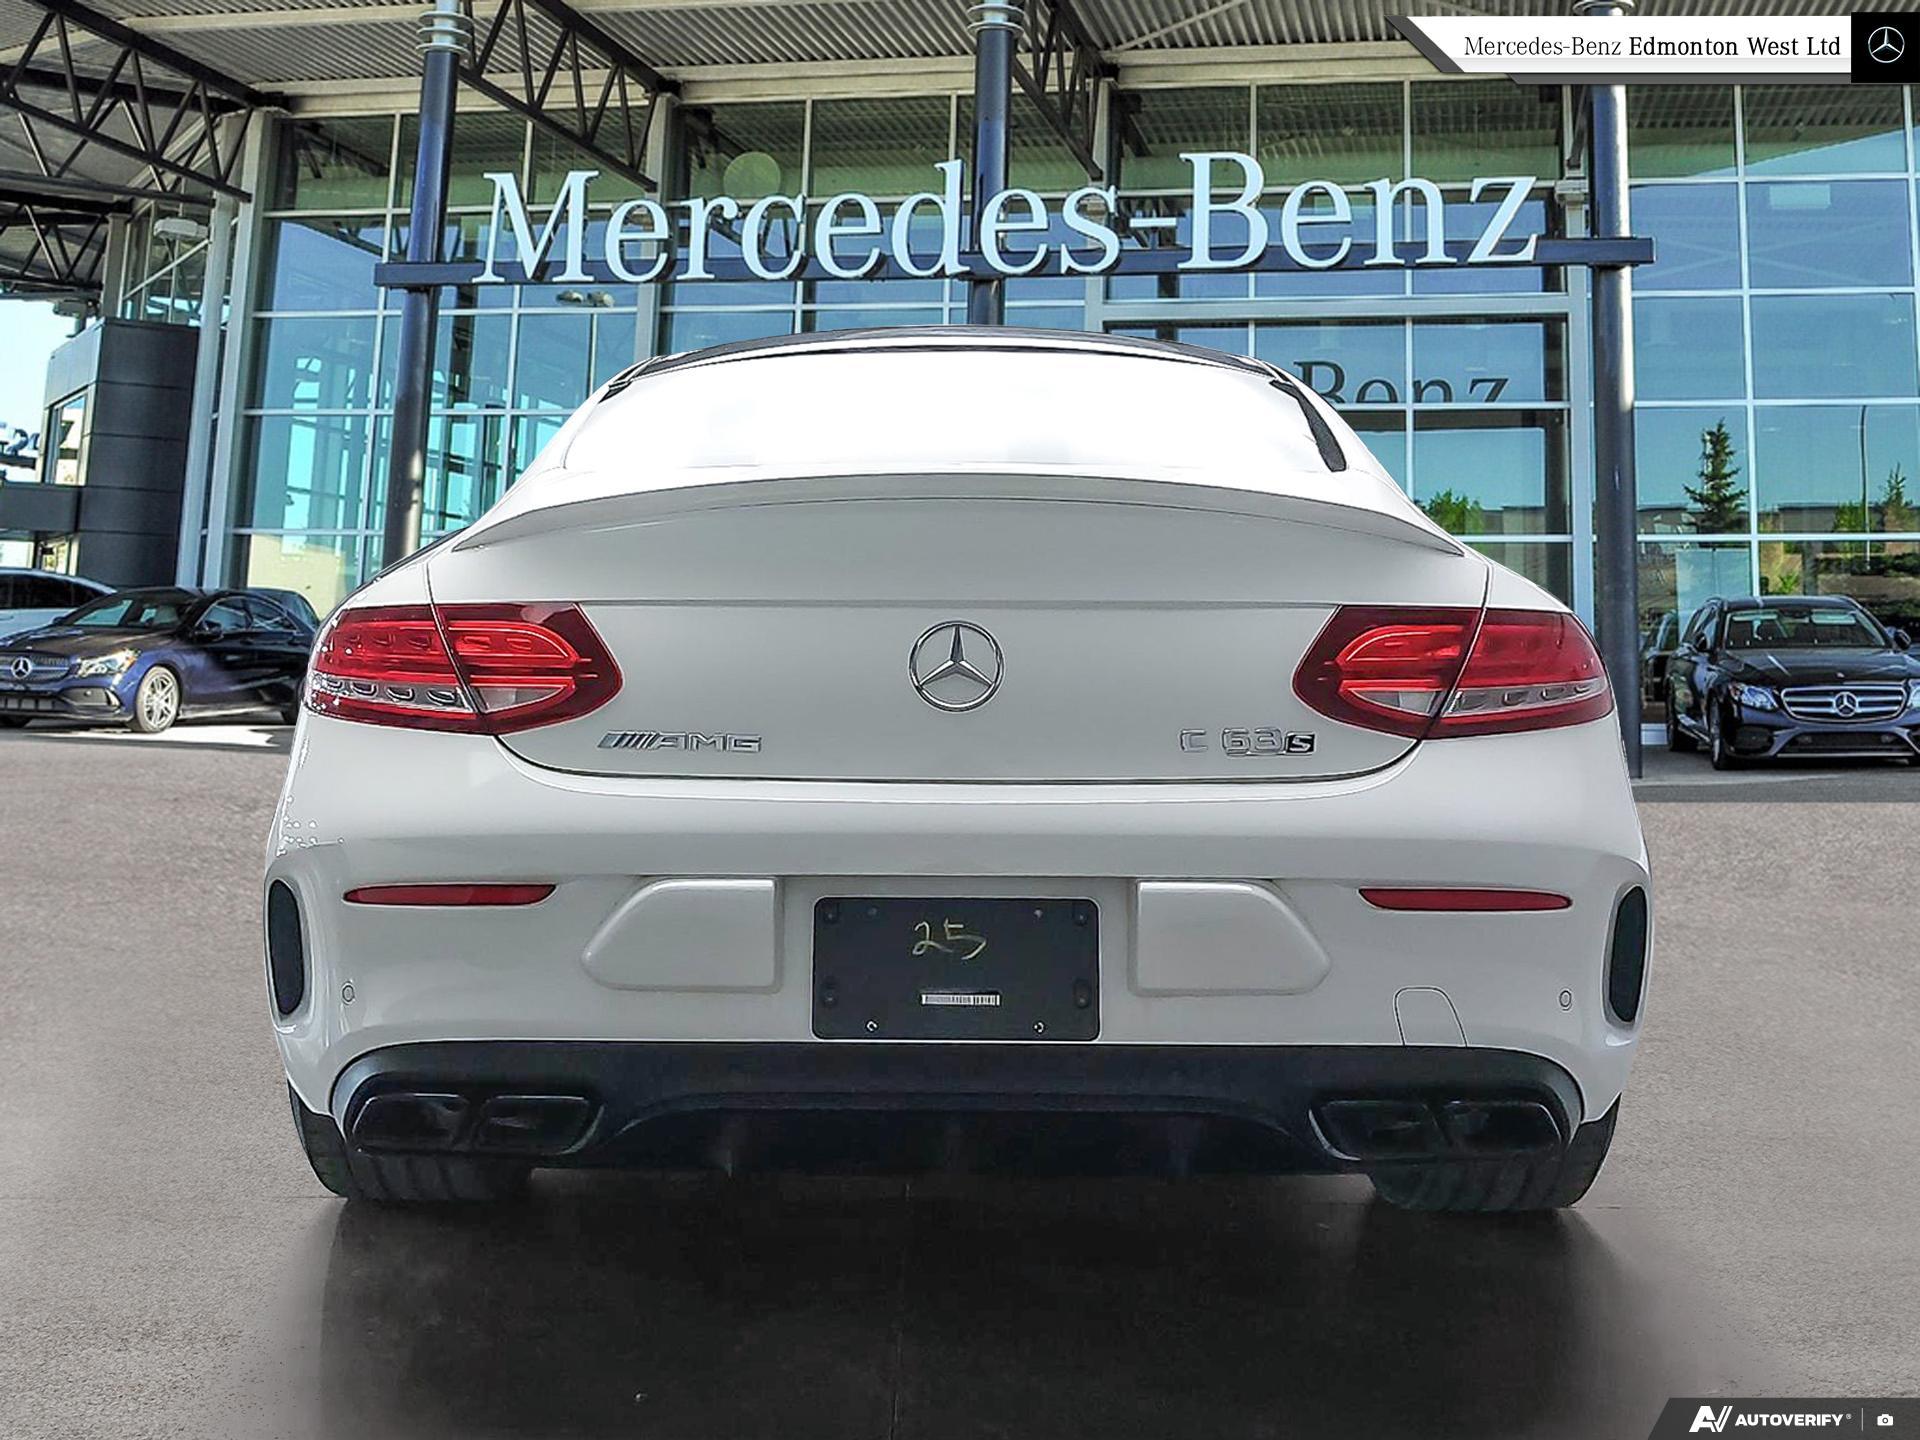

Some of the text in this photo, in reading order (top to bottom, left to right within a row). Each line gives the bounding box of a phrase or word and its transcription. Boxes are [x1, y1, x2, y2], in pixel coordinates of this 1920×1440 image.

[471, 151, 1539, 284] Mercedes-Benz
[1180, 728, 1209, 753] C
[912, 917, 988, 960] 25
